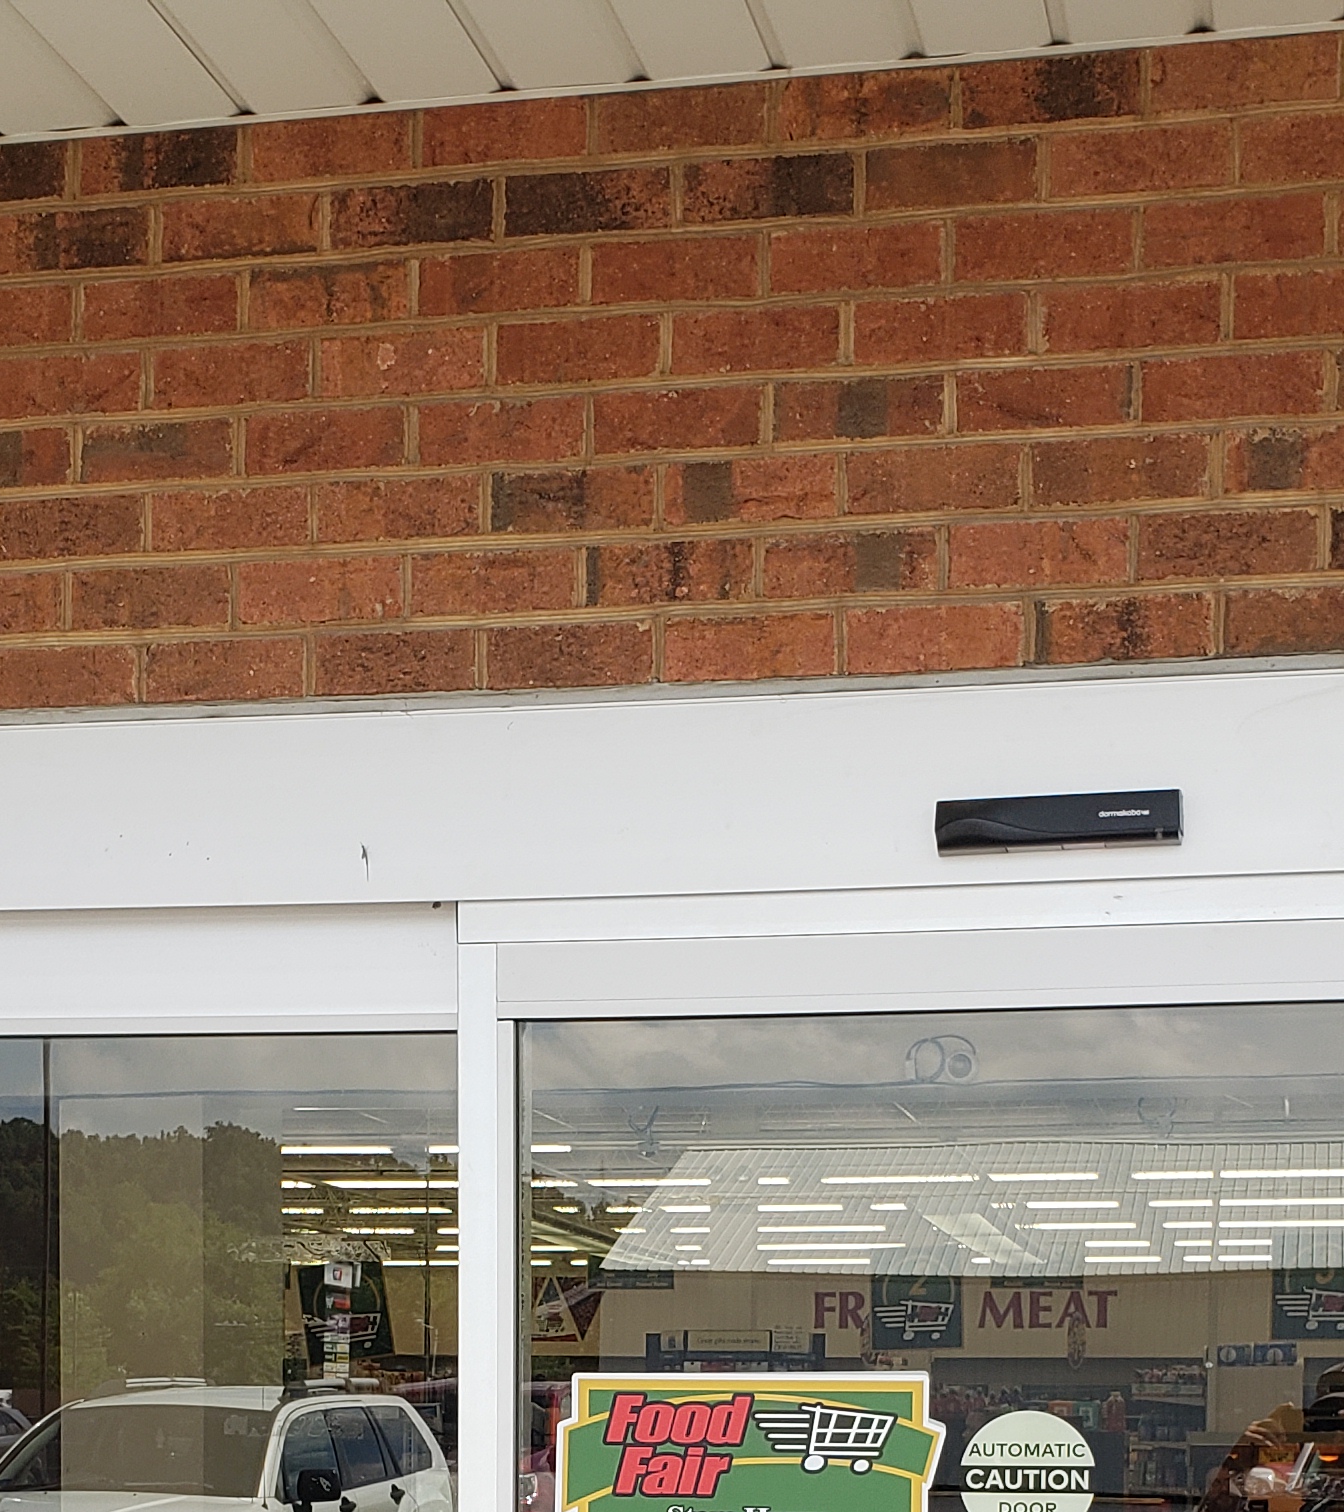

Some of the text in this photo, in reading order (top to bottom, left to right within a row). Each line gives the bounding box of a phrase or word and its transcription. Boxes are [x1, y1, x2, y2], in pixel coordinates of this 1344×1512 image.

[978, 1289, 1119, 1330] MEAT
[604, 1393, 754, 1445] Food
[968, 1443, 1086, 1458] AUTOMATIC
[613, 1446, 732, 1498] Fair
[965, 1468, 1090, 1490] CAUTION
